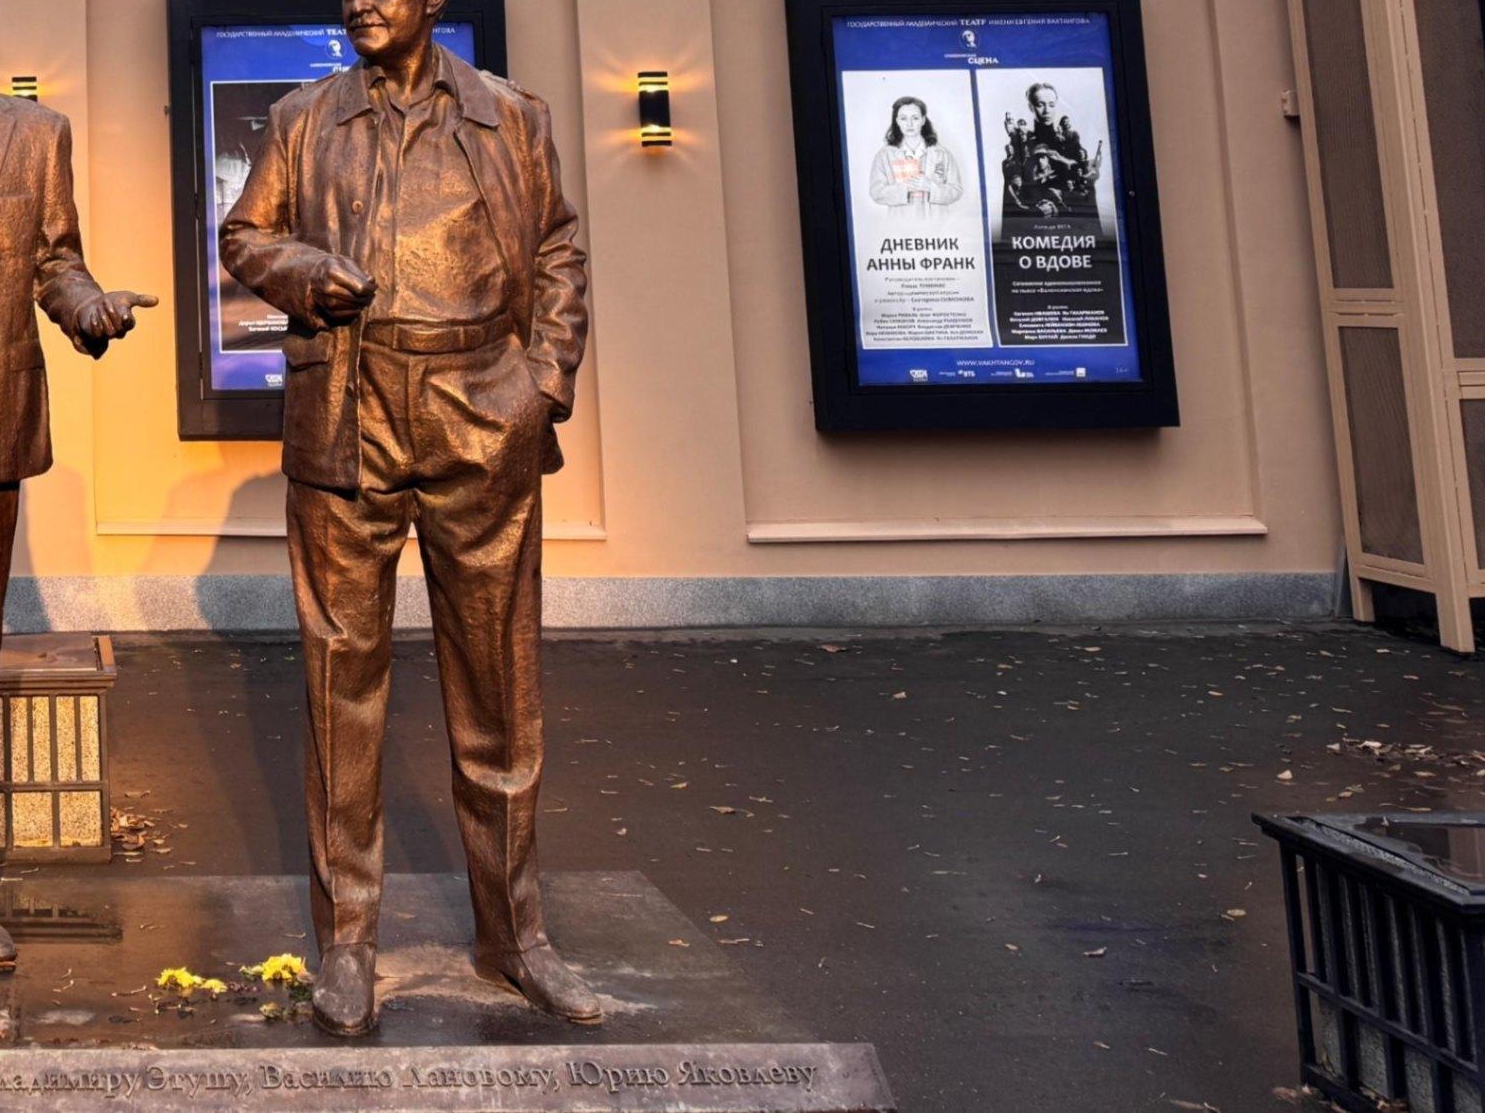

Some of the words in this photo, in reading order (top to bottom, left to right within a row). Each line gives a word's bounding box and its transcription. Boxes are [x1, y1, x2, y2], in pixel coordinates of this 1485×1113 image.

[968, 56, 999, 65] СЦЕНА
[880, 238, 959, 254] ДНЕВНИК
[1012, 235, 1096, 252] КОМЕДИЯ
[866, 258, 916, 271] АННЫ
[919, 257, 976, 270] ФРАНК
[1019, 256, 1032, 269] О
[1036, 255, 1092, 272] ВДОВЕ
[145, 1065, 253, 1097] Этушу,
[260, 1065, 394, 1091] Василию
[402, 1064, 561, 1093] Лановому,
[566, 1059, 670, 1093] Юрию
[677, 1060, 817, 1093] Яковлеву
